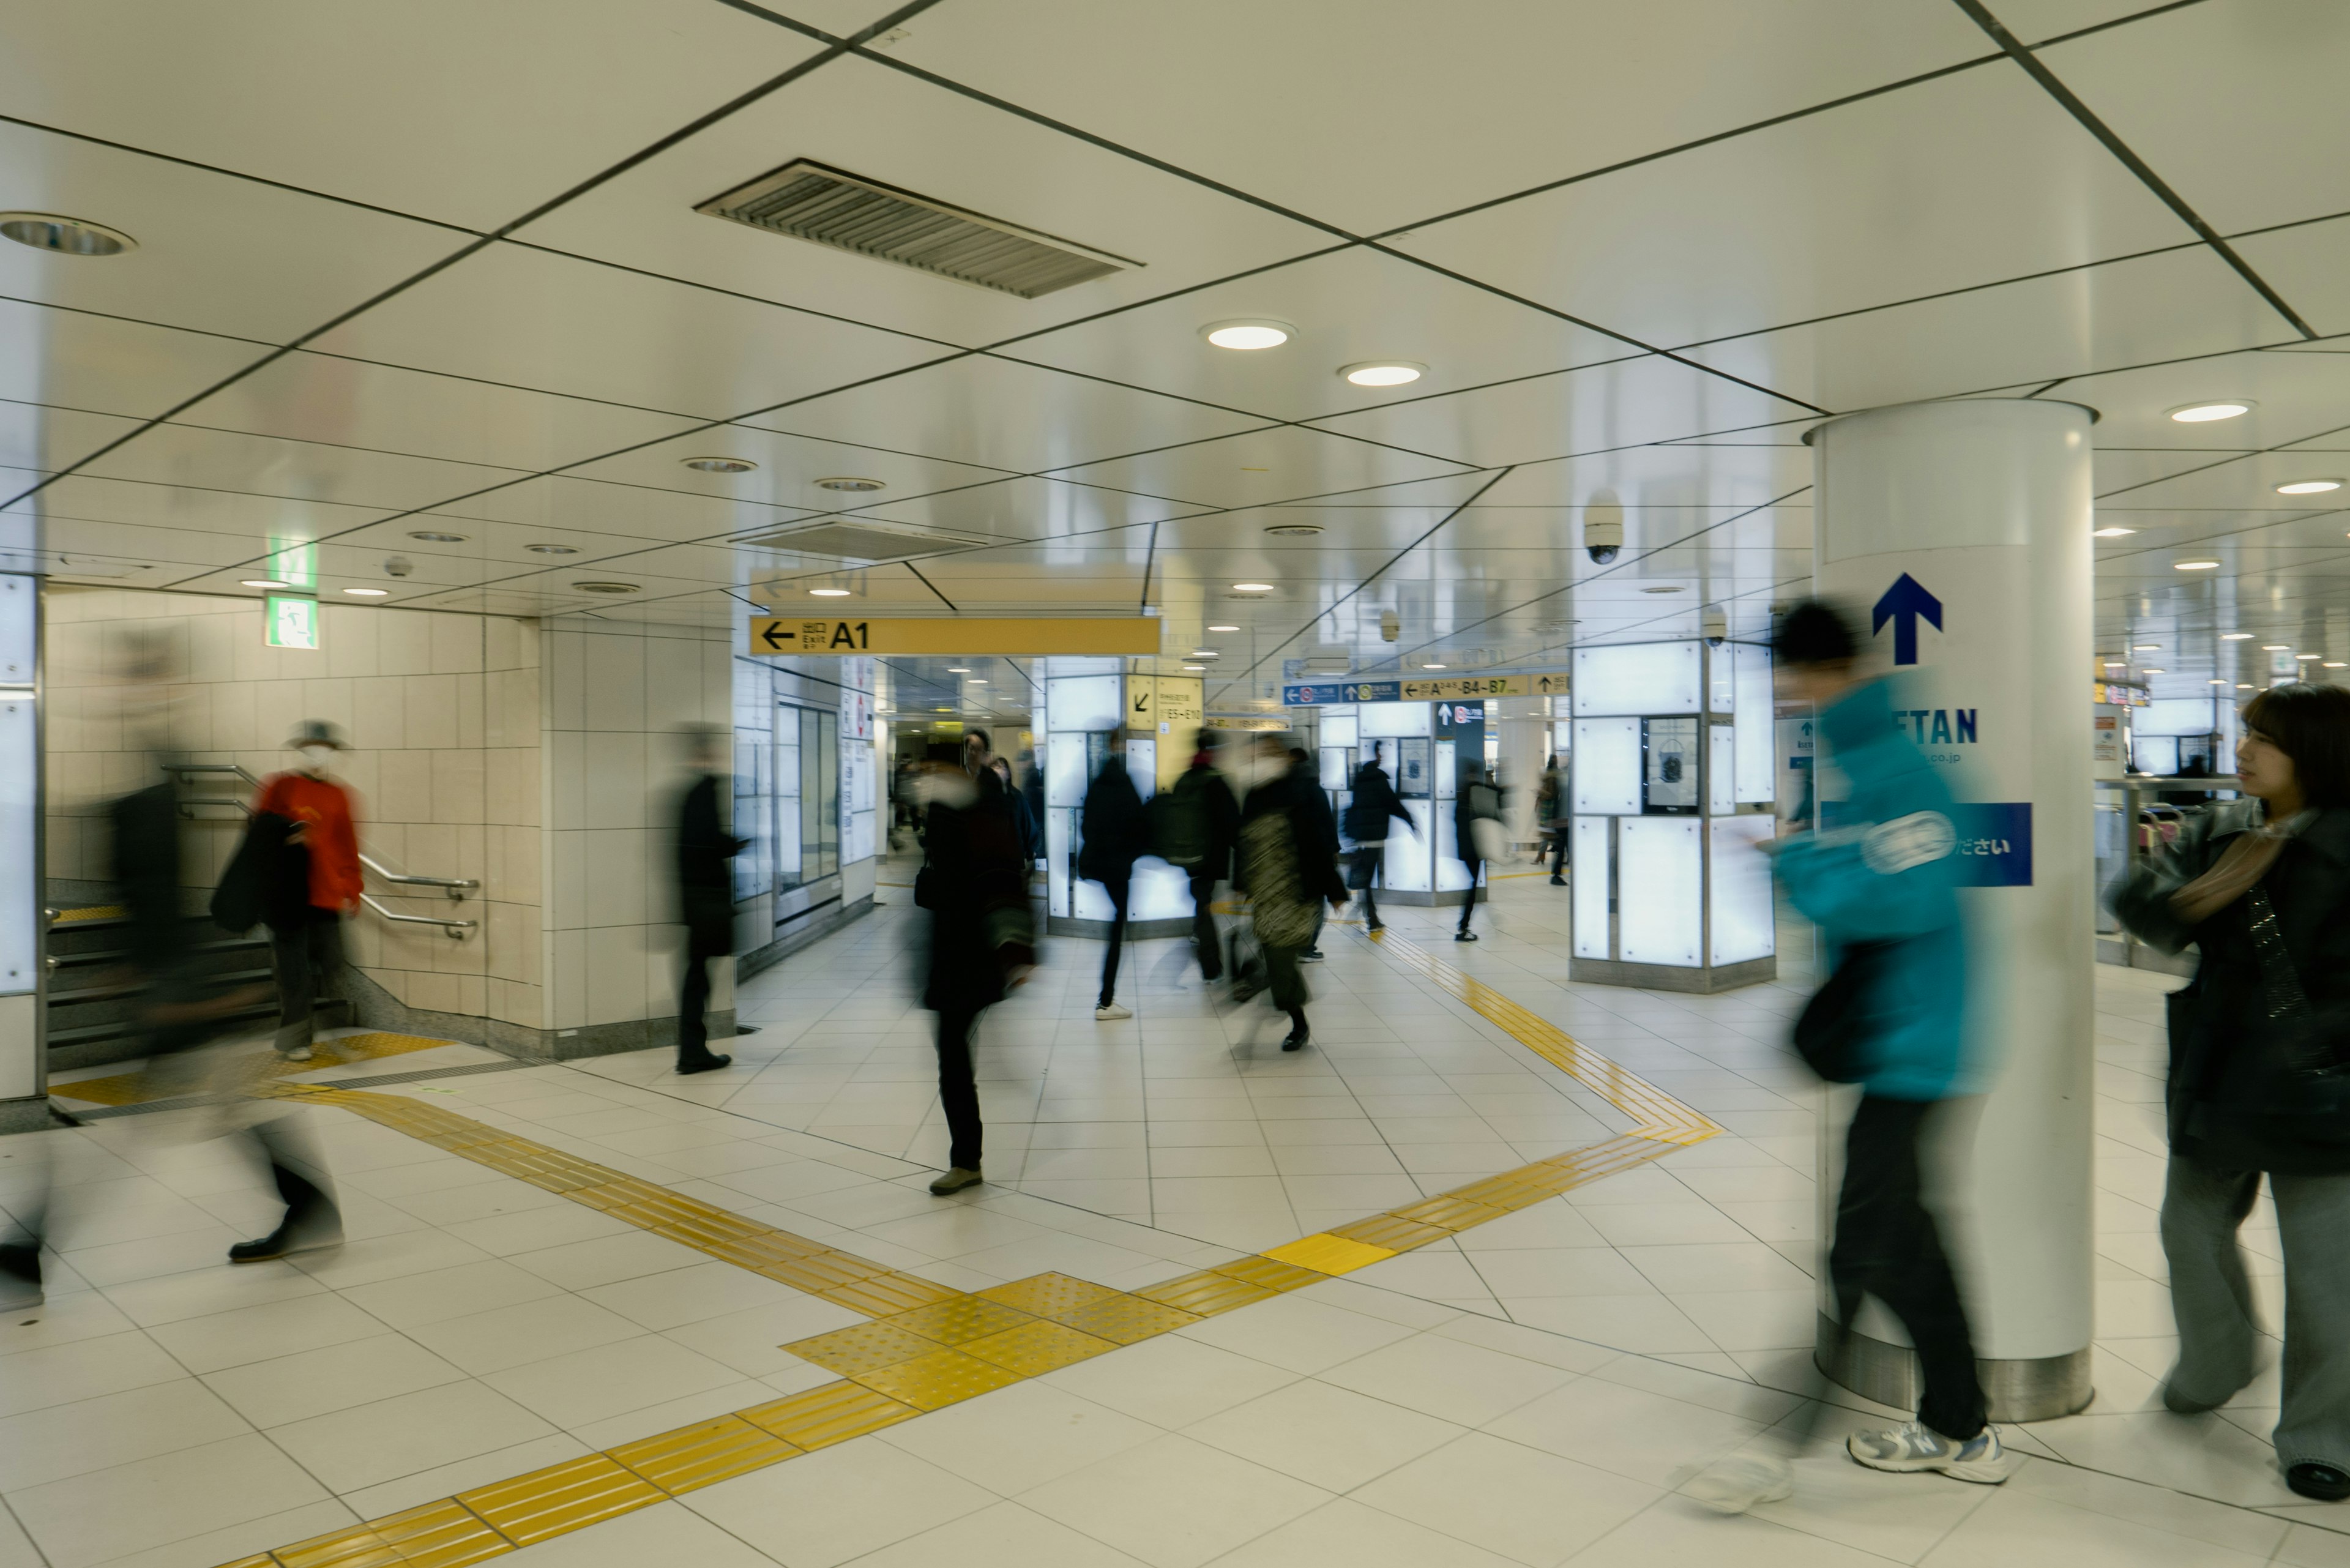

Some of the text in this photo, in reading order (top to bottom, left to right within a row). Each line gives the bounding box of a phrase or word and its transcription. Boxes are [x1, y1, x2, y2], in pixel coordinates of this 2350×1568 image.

[802, 622, 826, 633] 出口
[829, 622, 869, 649] A1
[802, 635, 826, 643] Exit
[1890, 709, 1978, 745] ETAN
[1926, 752, 1961, 764] .co.jp
[1956, 838, 2011, 856] ださい
[1913, 1435, 1938, 1454] N
